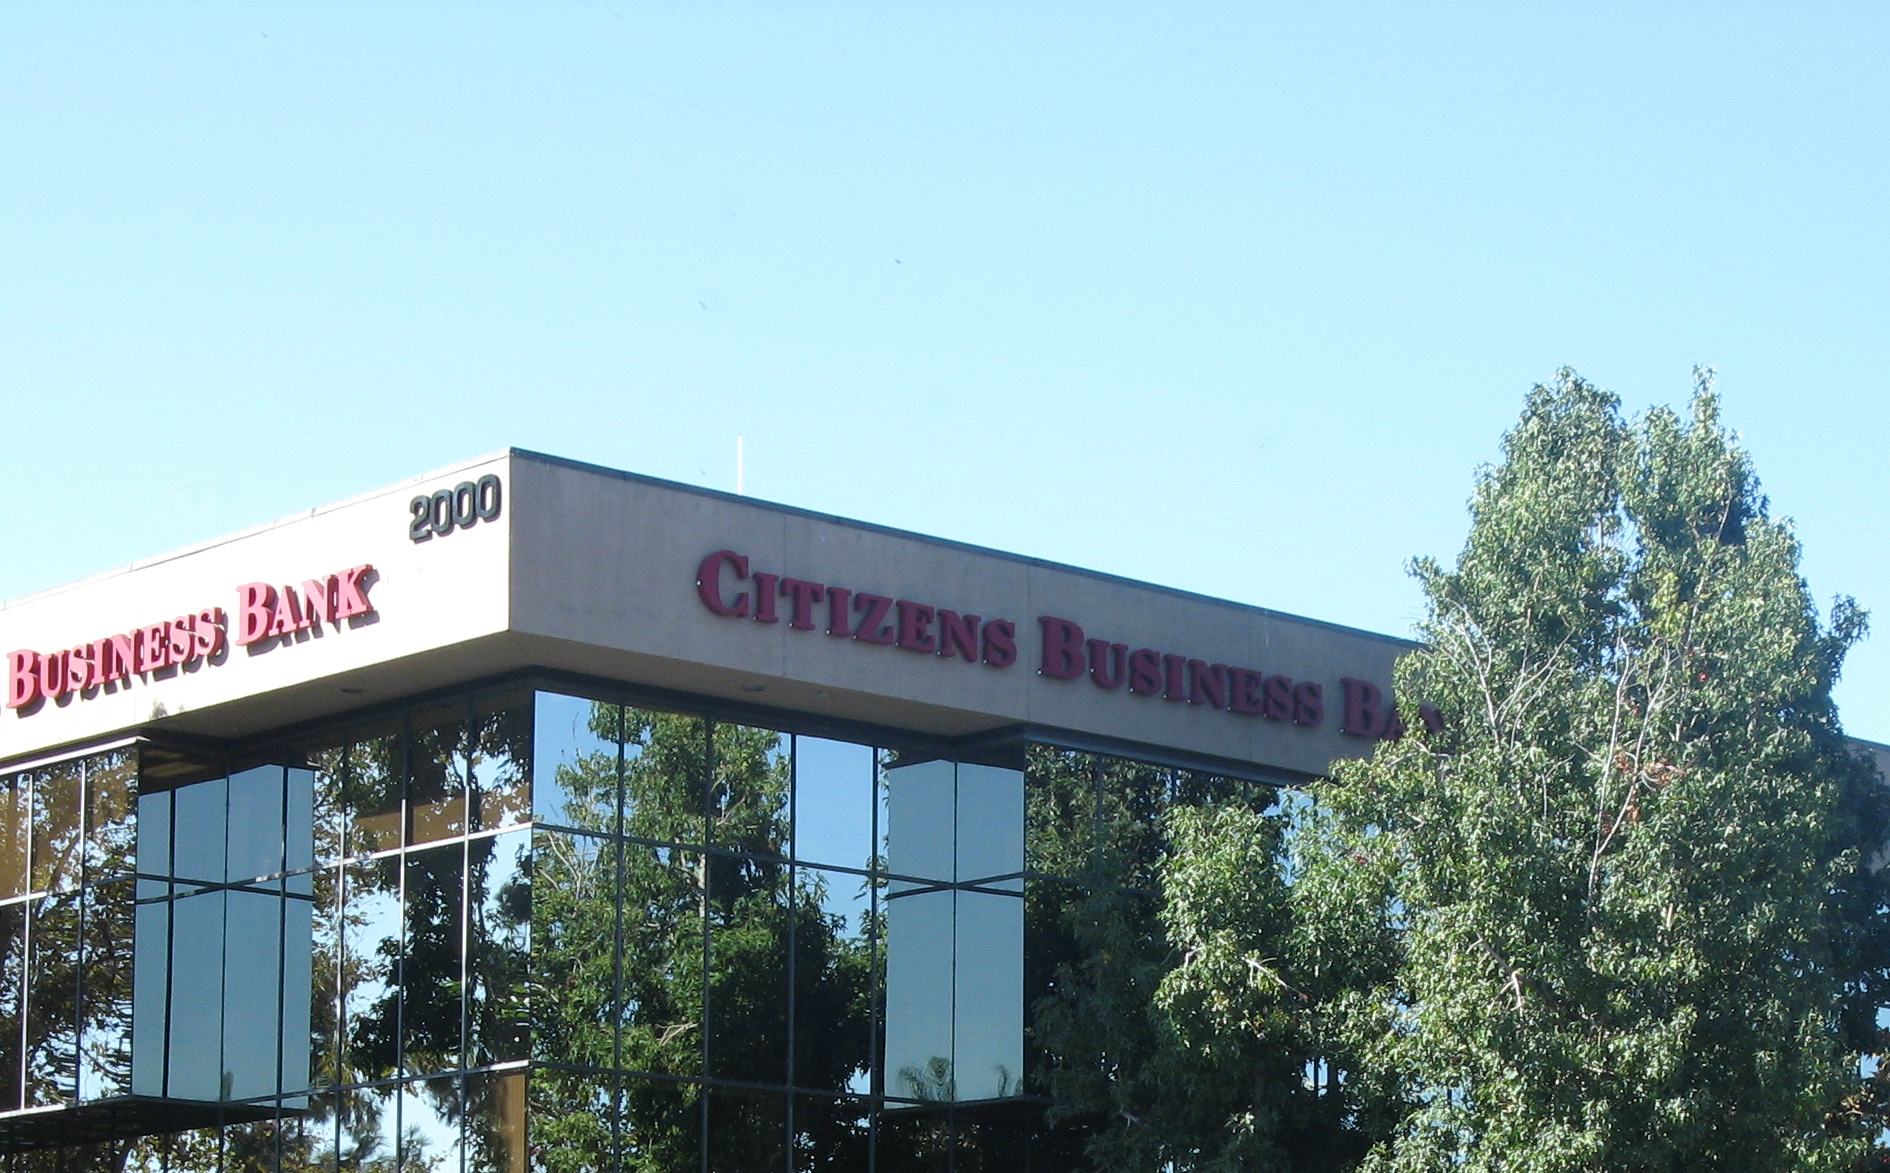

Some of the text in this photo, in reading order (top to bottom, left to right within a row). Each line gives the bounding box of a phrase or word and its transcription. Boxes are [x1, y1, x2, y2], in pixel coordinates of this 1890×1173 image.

[409, 474, 501, 543] 2000
[6, 563, 375, 709] BUSINESS BANK
[696, 550, 1017, 668] CITIZENS
[1038, 614, 1325, 729] BUSINESS
